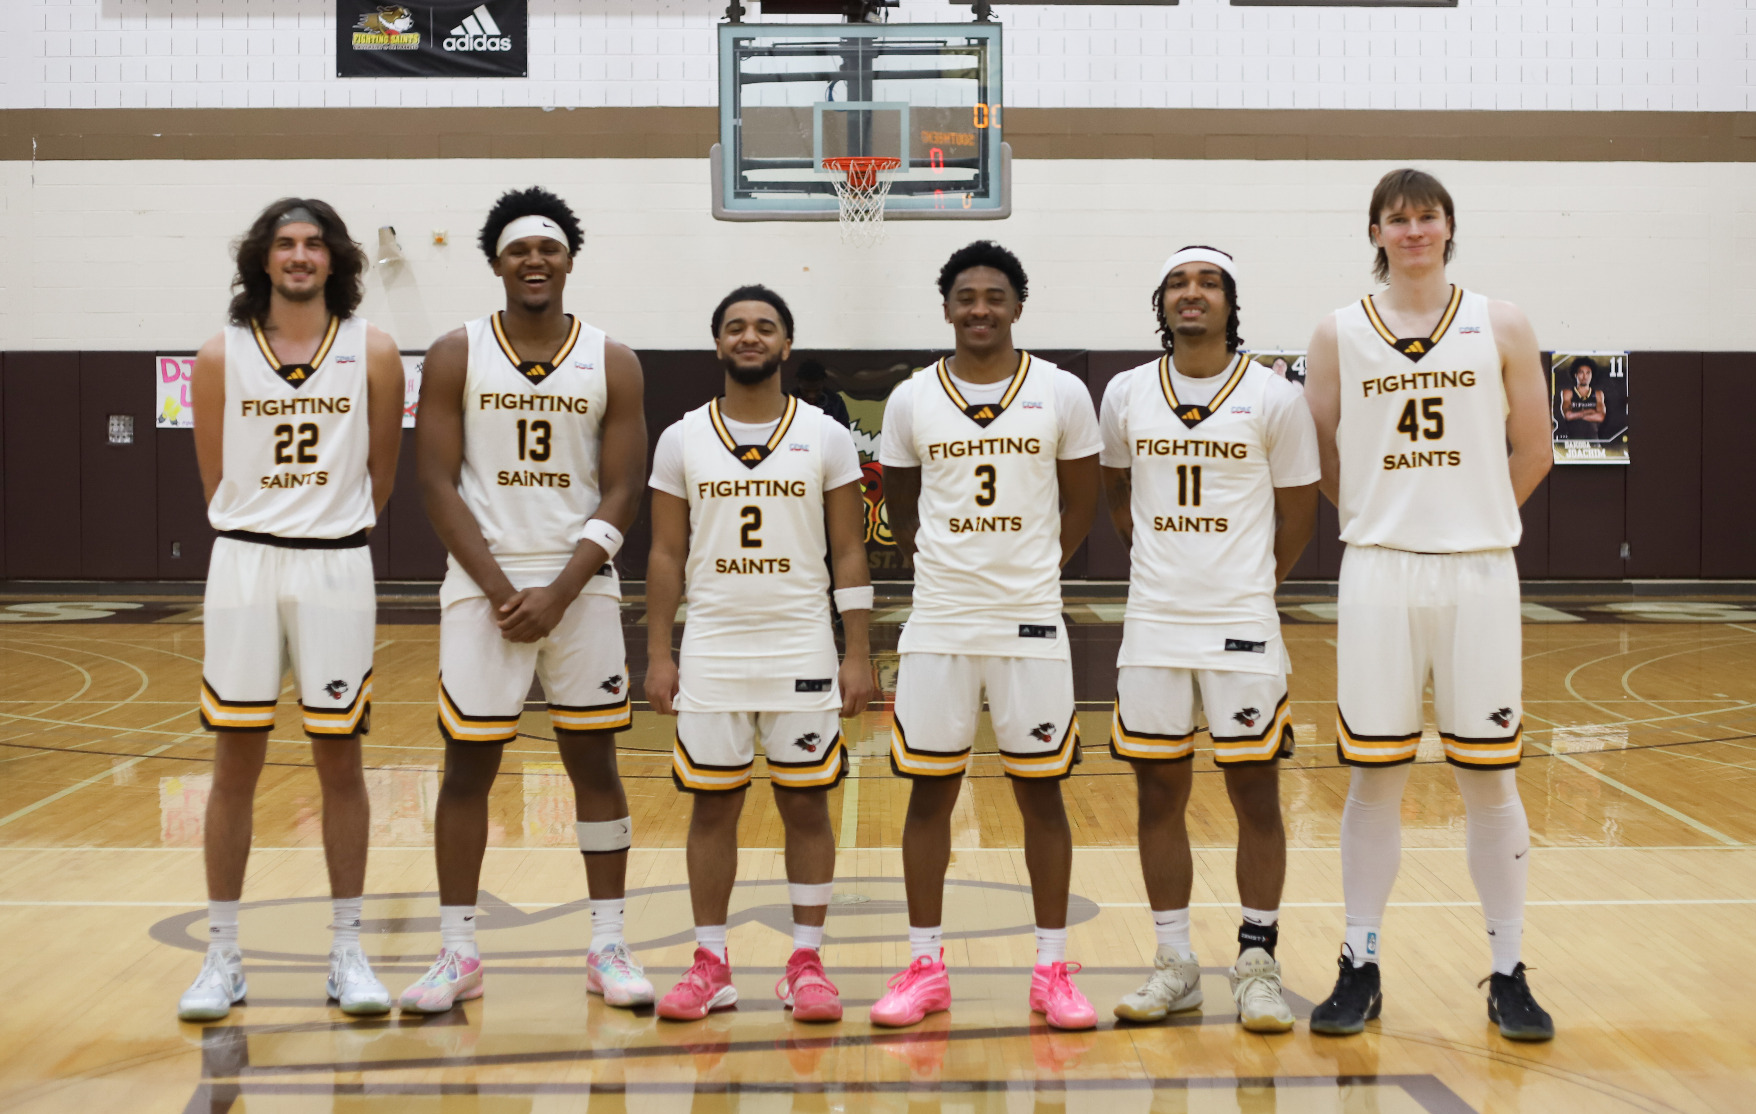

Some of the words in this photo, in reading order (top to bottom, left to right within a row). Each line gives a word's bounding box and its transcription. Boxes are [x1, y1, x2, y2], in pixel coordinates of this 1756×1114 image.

[443, 34, 511, 52] adidas
[1291, 355, 1307, 376] 4
[1609, 356, 1624, 377] 11
[1362, 370, 1476, 398] FIGHTING
[241, 397, 351, 416] FIGHTING
[480, 393, 589, 415] FIGHTING
[1396, 397, 1444, 442] 45
[274, 422, 319, 465] 22
[516, 418, 552, 462] 13
[928, 437, 1041, 461] FIGHTING
[1136, 439, 1248, 460] FIGHTING
[698, 480, 806, 500] FIGHTING
[974, 463, 996, 507] 3
[1176, 464, 1202, 507] 11
[740, 504, 763, 549] 2
